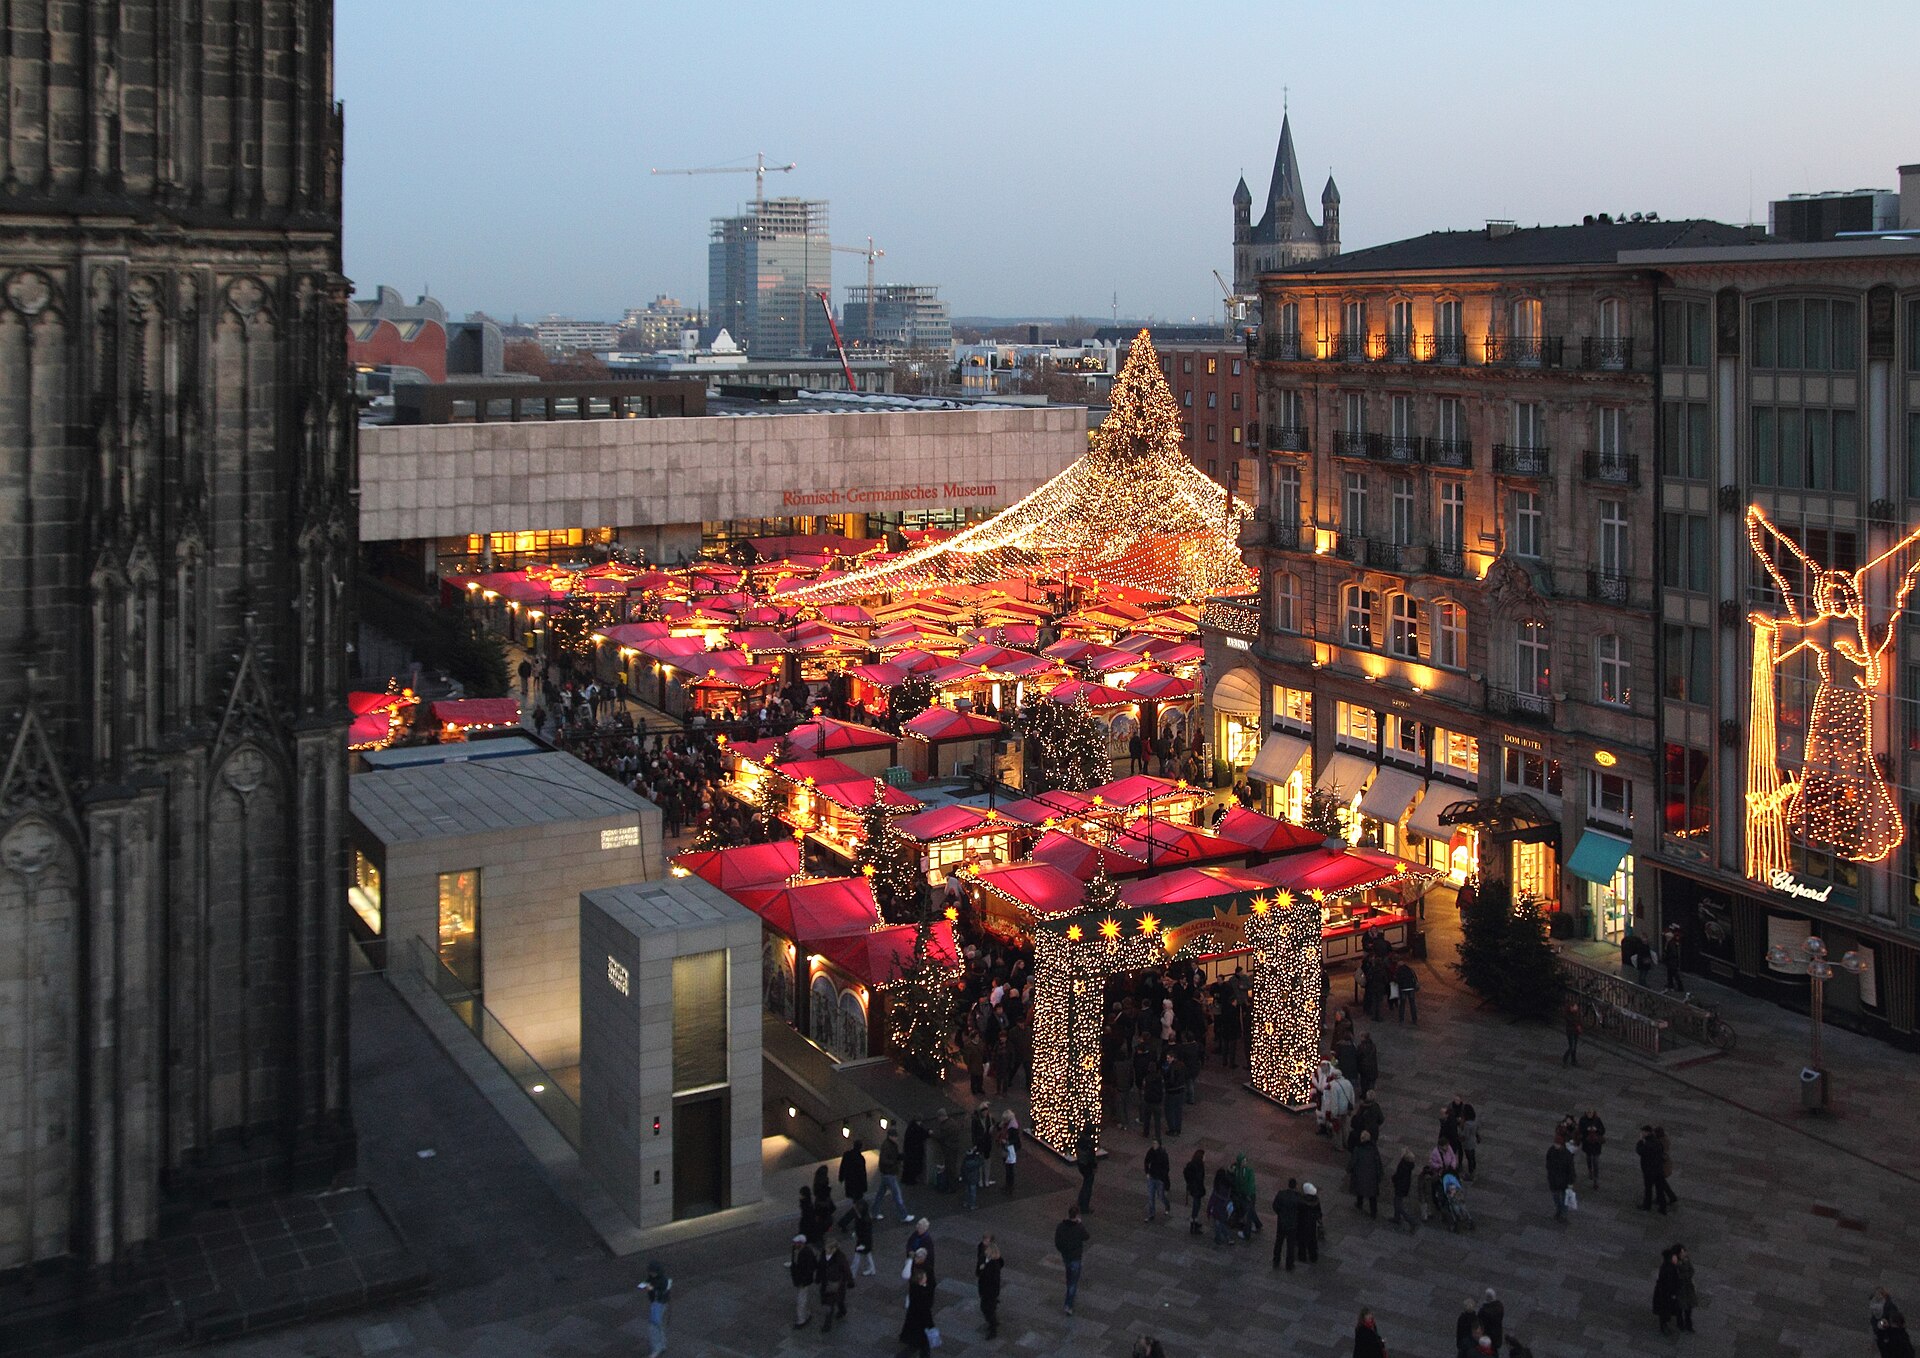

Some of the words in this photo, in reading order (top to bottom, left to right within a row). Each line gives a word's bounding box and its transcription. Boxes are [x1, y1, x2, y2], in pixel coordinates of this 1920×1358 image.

[783, 486, 938, 506] Römisch-Germanisches
[943, 483, 997, 499] Museum
[1504, 734, 1520, 745] DOM
[1520, 738, 1543, 751] HOTEL
[1769, 868, 1833, 902] Chopard
